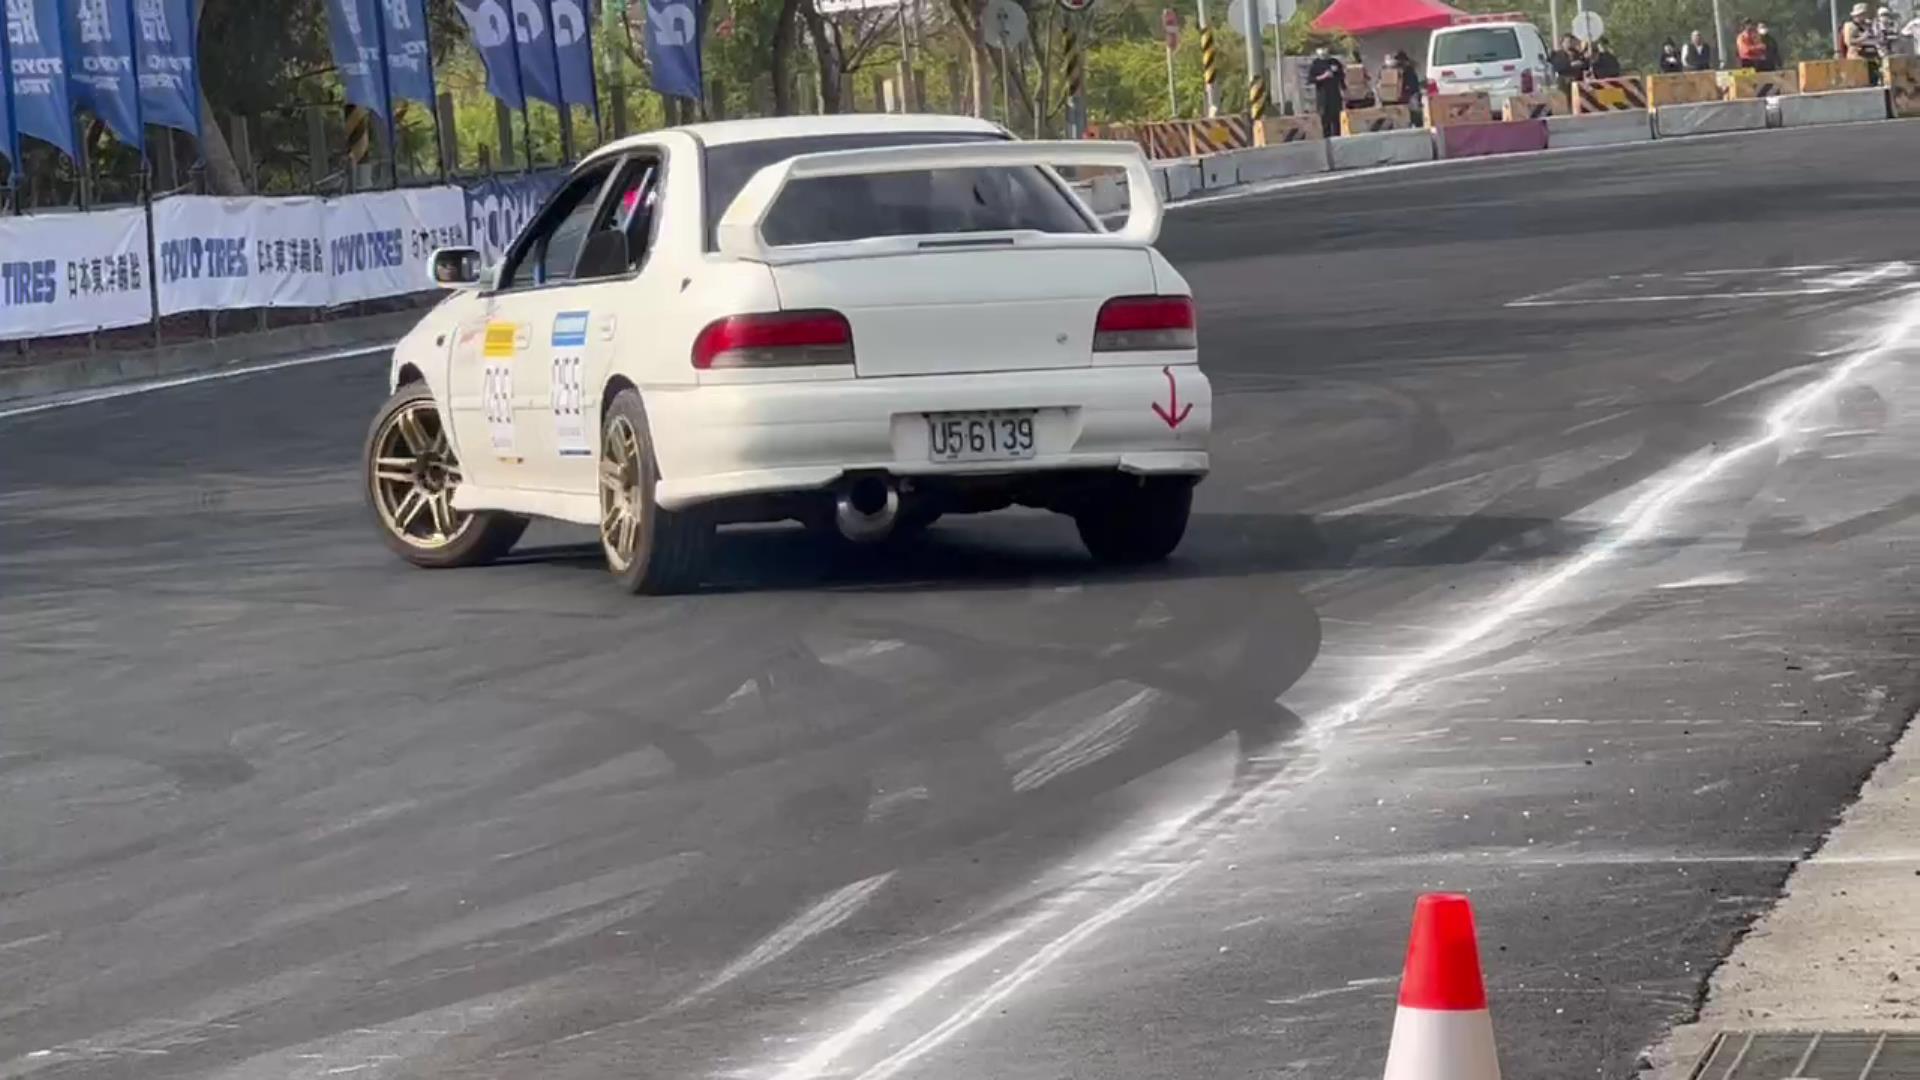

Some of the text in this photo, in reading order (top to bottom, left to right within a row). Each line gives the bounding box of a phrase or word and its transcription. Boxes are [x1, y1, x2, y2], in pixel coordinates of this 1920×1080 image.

[161, 236, 248, 282] TOYO TIRES
[331, 232, 366, 276] TOYO
[1, 259, 56, 306] TIRES
